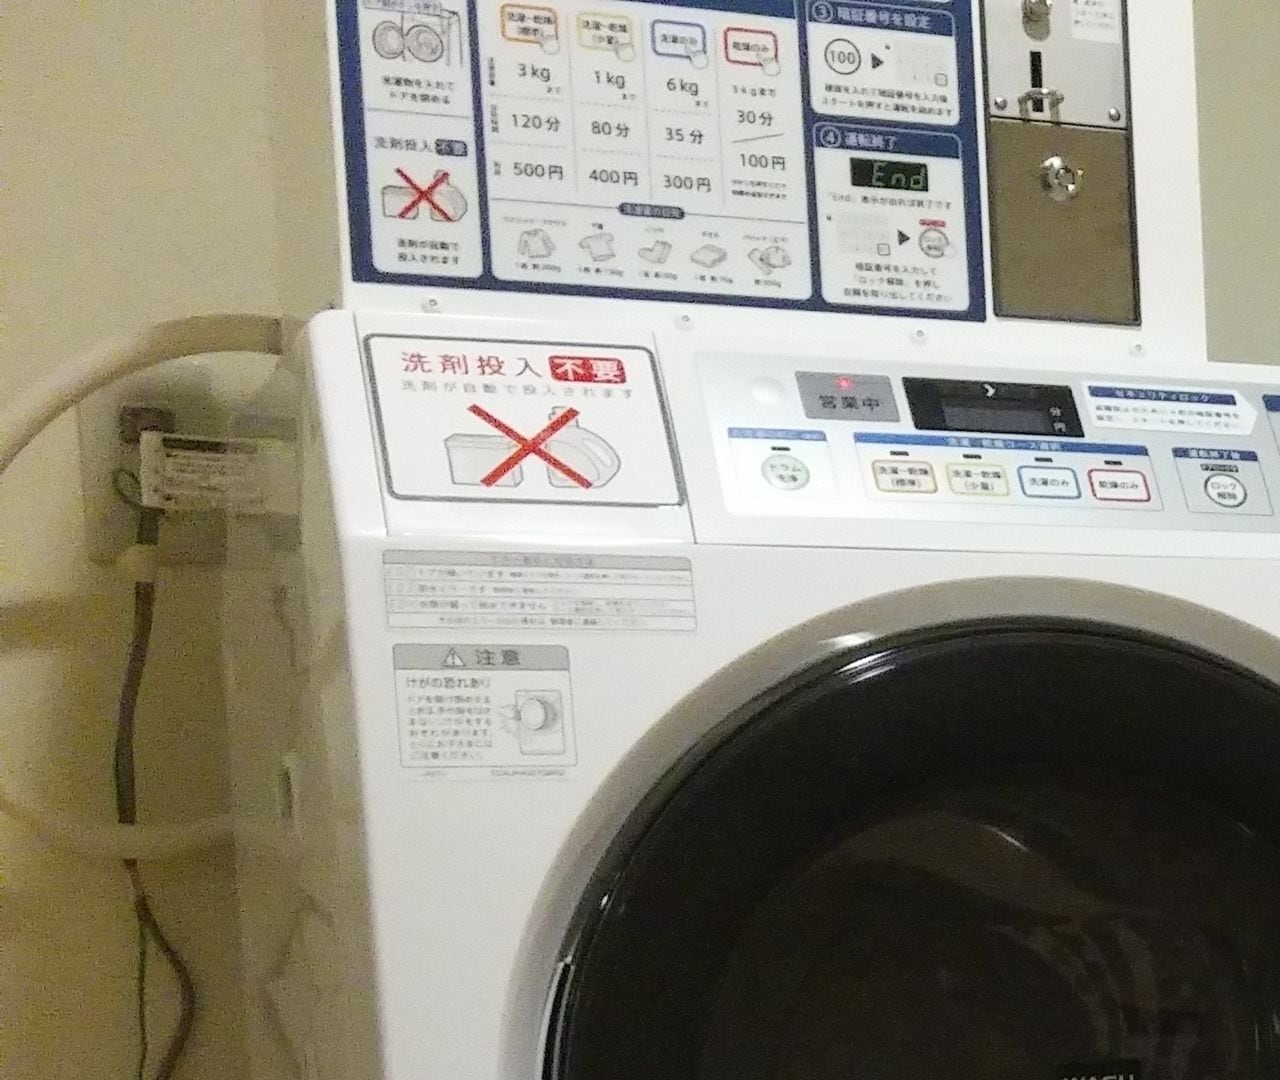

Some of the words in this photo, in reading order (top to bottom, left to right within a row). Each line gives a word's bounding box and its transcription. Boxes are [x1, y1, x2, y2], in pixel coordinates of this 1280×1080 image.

[829, 51, 856, 64] 100
[511, 113, 561, 132] 120分
[736, 109, 774, 126] 30分
[591, 121, 630, 137] 80分
[665, 127, 704, 144] 35分
[513, 161, 563, 180] 500円
[739, 153, 786, 171] 100円
[589, 169, 638, 186] 400円
[664, 174, 711, 192] 300円
[871, 161, 927, 189] End
[401, 351, 543, 378] 洗剤投入
[551, 356, 626, 384] 不要
[402, 380, 633, 399] 洗剤が自動で投入されます
[476, 649, 520, 666] 注意
